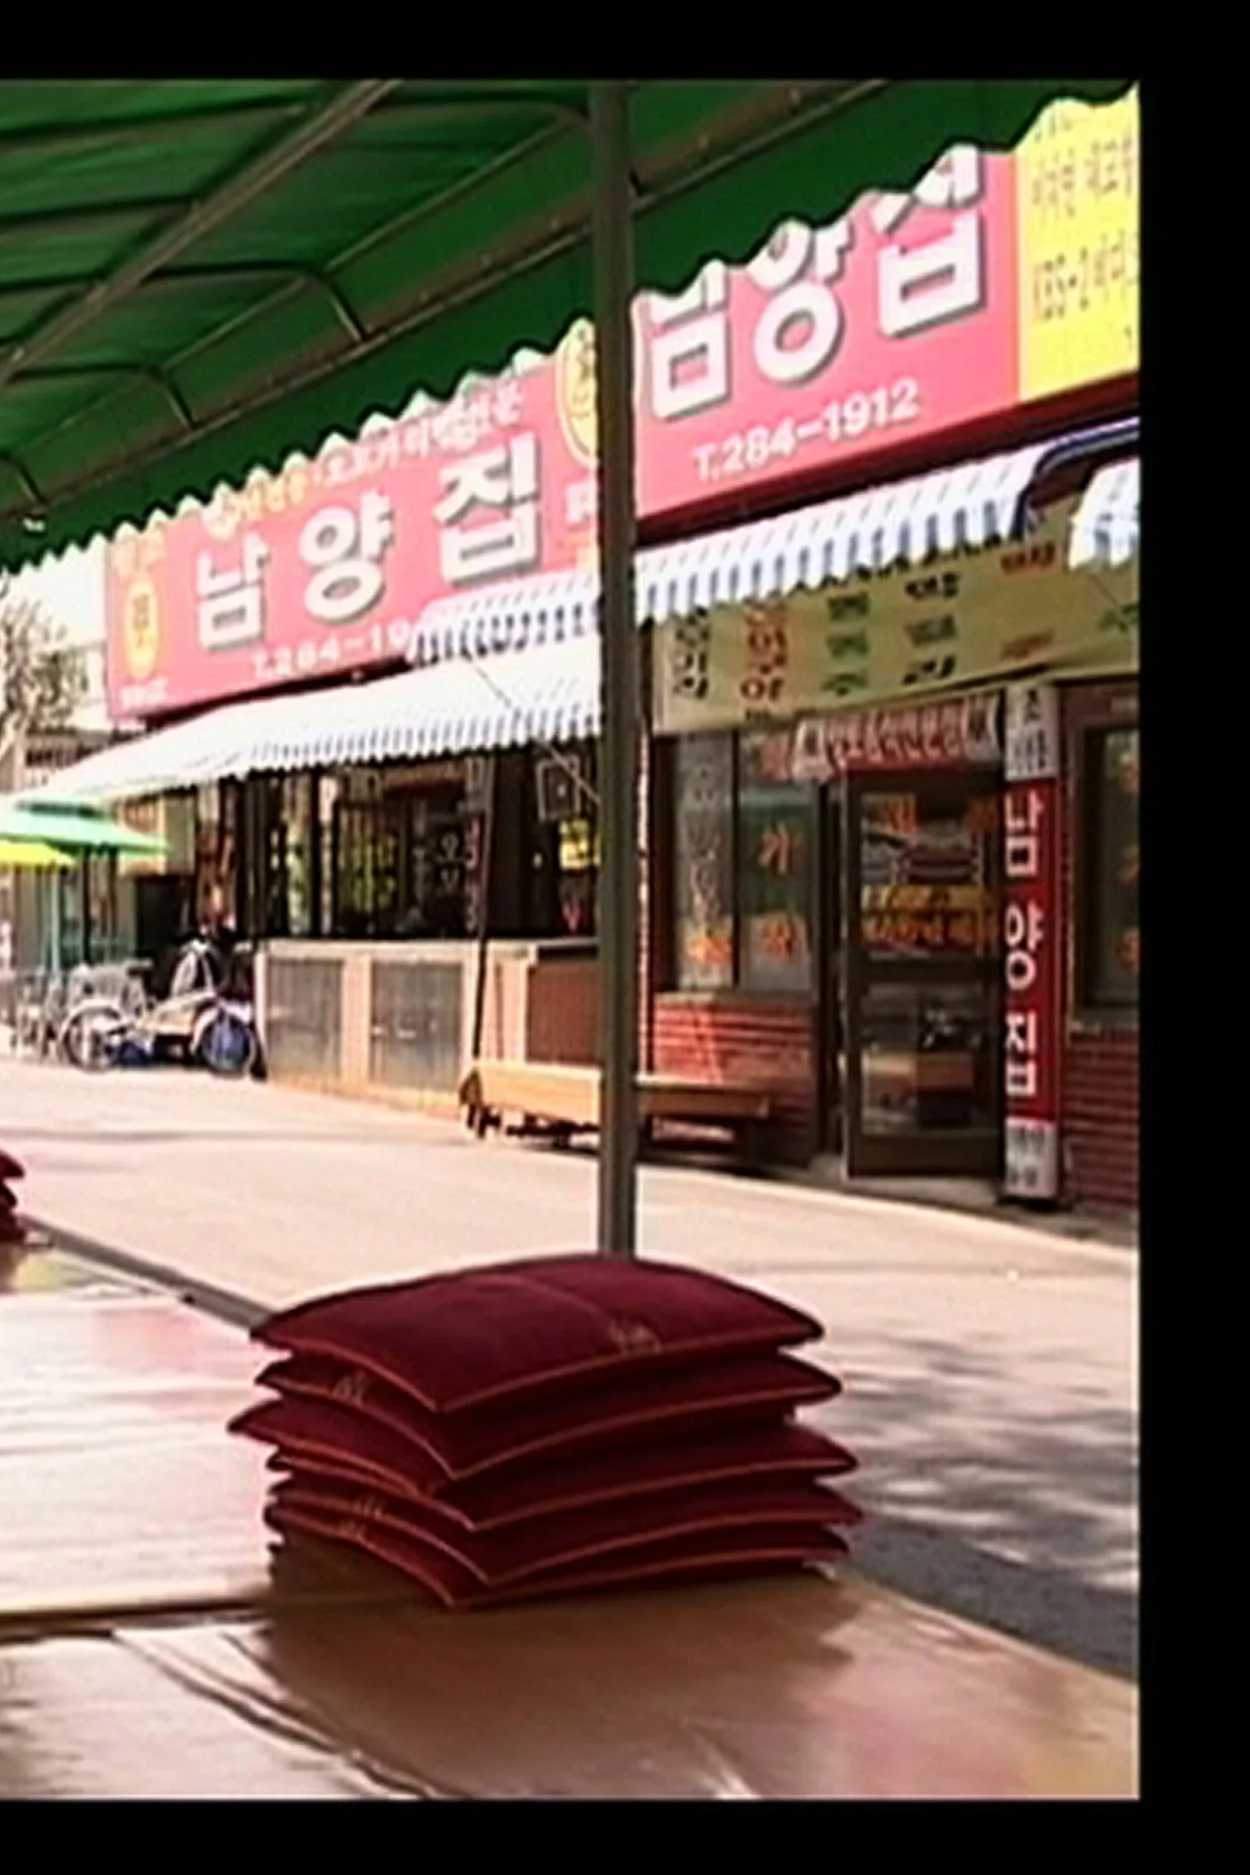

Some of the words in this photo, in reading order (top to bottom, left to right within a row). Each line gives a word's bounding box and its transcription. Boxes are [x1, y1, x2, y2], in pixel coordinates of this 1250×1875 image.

[693, 378, 920, 482] T.284-1912
[196, 432, 542, 650] 남양집
[1005, 789, 1044, 1097] 남양집
